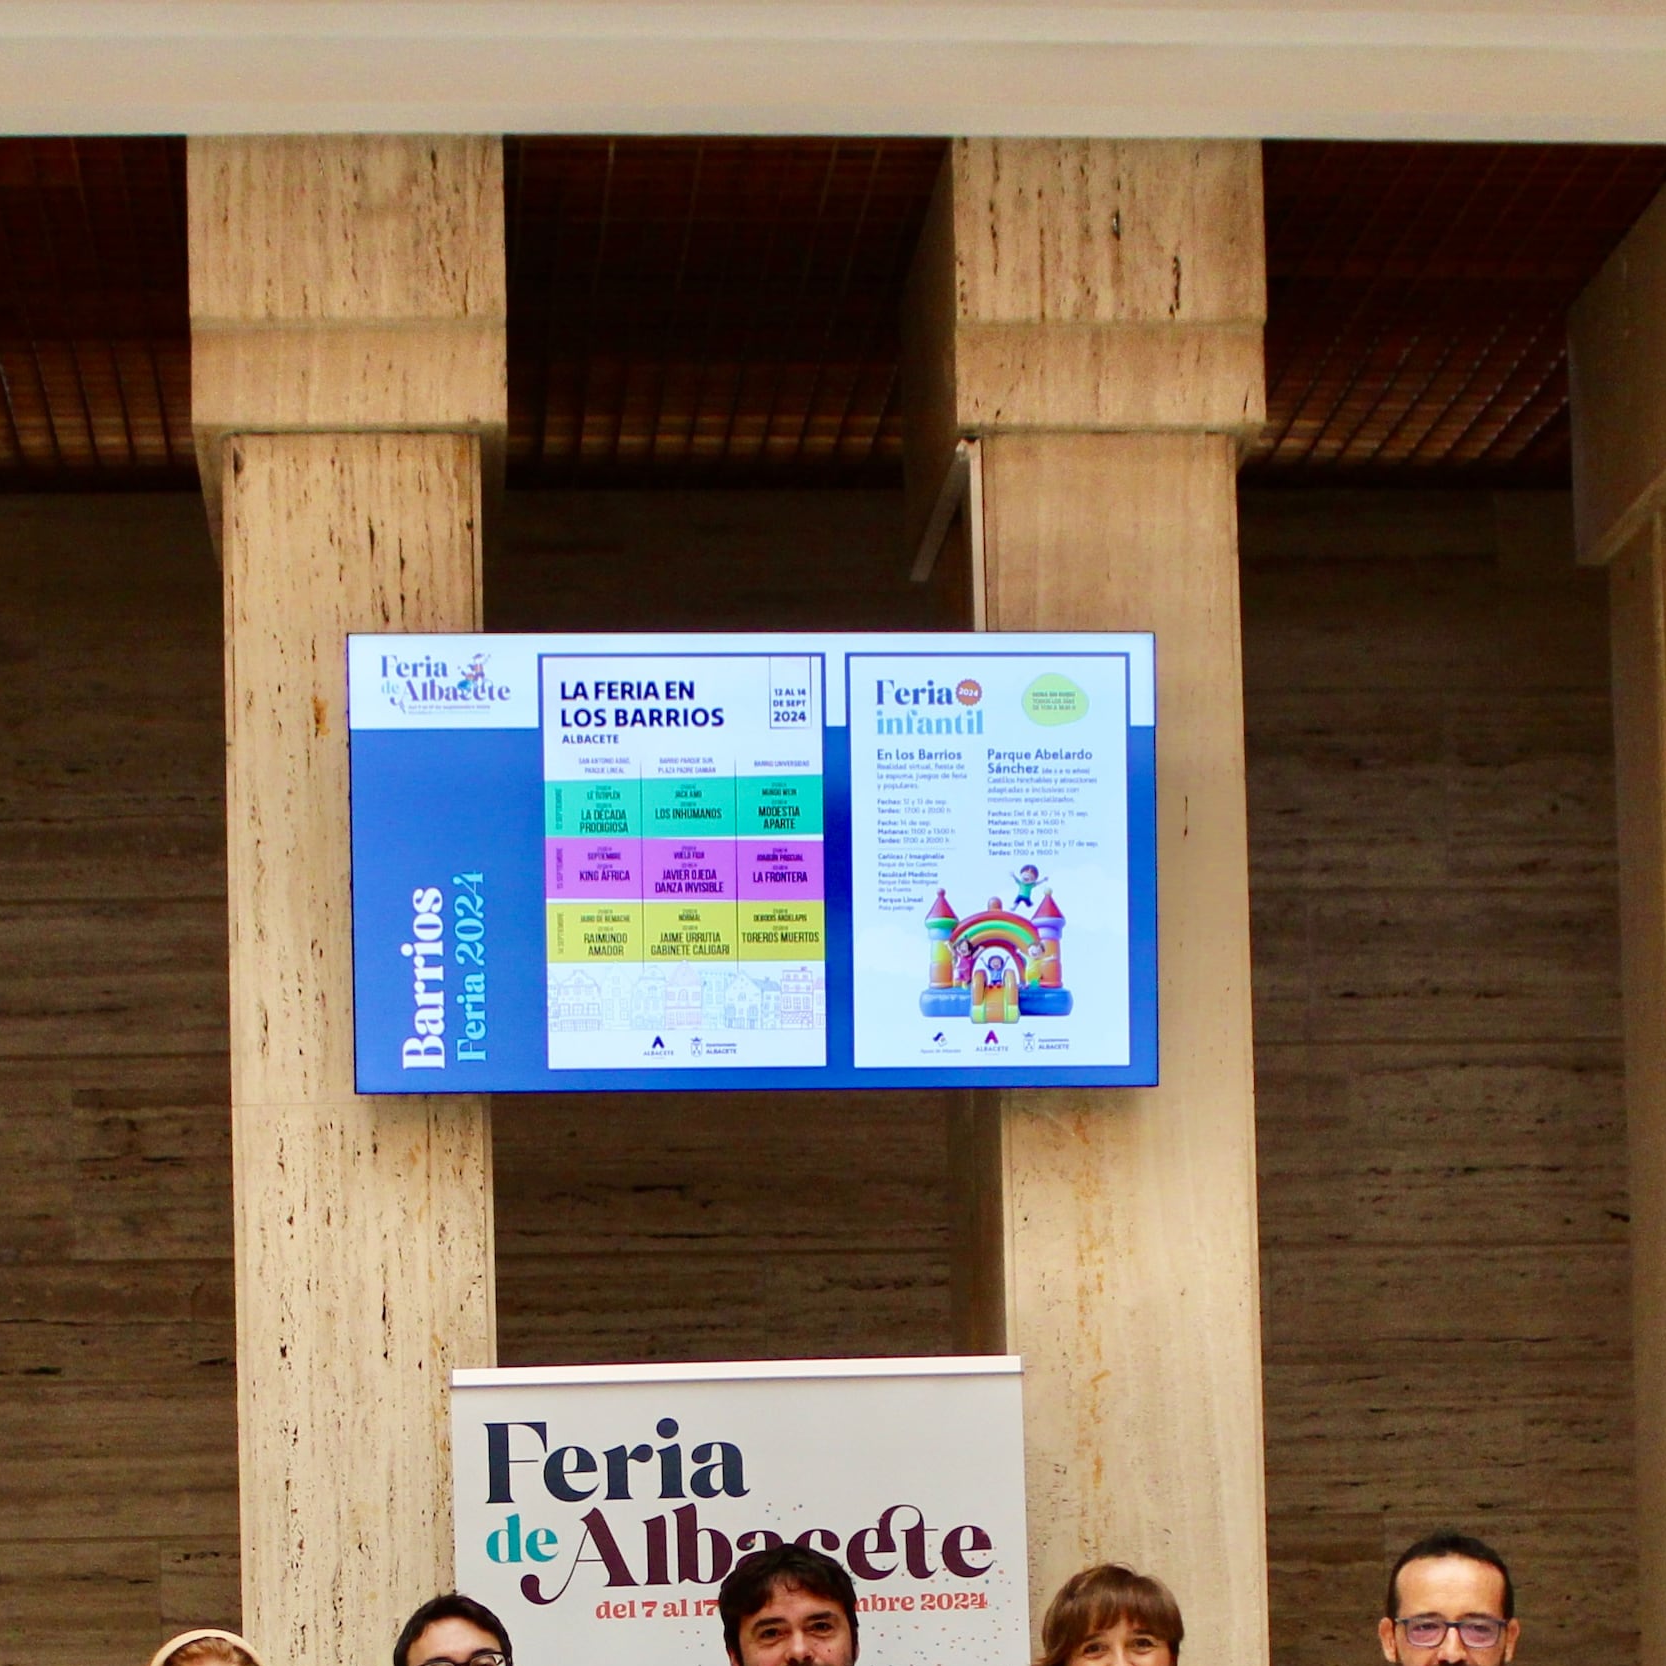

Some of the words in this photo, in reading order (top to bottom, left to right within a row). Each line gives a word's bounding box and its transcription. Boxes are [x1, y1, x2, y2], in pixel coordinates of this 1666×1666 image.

[381, 655, 448, 678] Feria
[381, 680, 400, 695] de
[390, 679, 511, 708] Albacete
[560, 681, 589, 700] LA
[594, 681, 659, 700] FERIA
[665, 681, 695, 700] EN
[785, 688, 795, 696] AL
[876, 679, 954, 706] Feria
[959, 687, 979, 698] 2024
[786, 699, 806, 707] SEPT
[560, 708, 607, 728] LOS
[614, 708, 725, 727] BARRIOS
[773, 711, 807, 722] 2024
[876, 709, 984, 735] infantil
[562, 734, 620, 745] ALBACETE
[877, 748, 892, 760] En
[895, 748, 915, 760] los
[918, 748, 962, 760] Barrios
[987, 748, 1031, 763] Parque
[1035, 748, 1093, 760] Abelardo
[987, 762, 1039, 774] Sánchez
[581, 809, 592, 820] LA
[594, 808, 627, 820] DÉCADA
[655, 808, 671, 819] LOS
[672, 808, 722, 819] INHUMANOS
[758, 806, 800, 817] MODESTIA
[580, 822, 629, 833] PRODIGIOSA
[763, 818, 796, 829] APARTE
[579, 870, 599, 881] KING
[662, 869, 690, 880] JAVIER
[691, 869, 717, 880] OJEDA
[753, 872, 763, 883] LA
[765, 871, 808, 883] FRONTERA
[655, 882, 683, 893] DANZA
[685, 882, 724, 893] INVISIBLE
[452, 871, 485, 966] 2024
[584, 932, 628, 943] RAIMUNDO
[660, 932, 684, 943] JAIME
[685, 932, 721, 943] URRUTIA
[741, 932, 779, 943] TOREROS
[780, 931, 820, 943] MUERTOS
[588, 945, 624, 956] AMADOR
[650, 944, 690, 955] GABINETE
[692, 944, 730, 955] CALIGARI
[400, 887, 445, 1070] Barrios
[456, 972, 487, 1061] Feria
[483, 1417, 750, 1505] Feria
[486, 1514, 559, 1564] de
[595, 1599, 635, 1621] del
[641, 1601, 657, 1619] 7
[661, 1597, 689, 1618] al
[693, 1598, 719, 1618] 17
[921, 1591, 988, 1611] 2024
